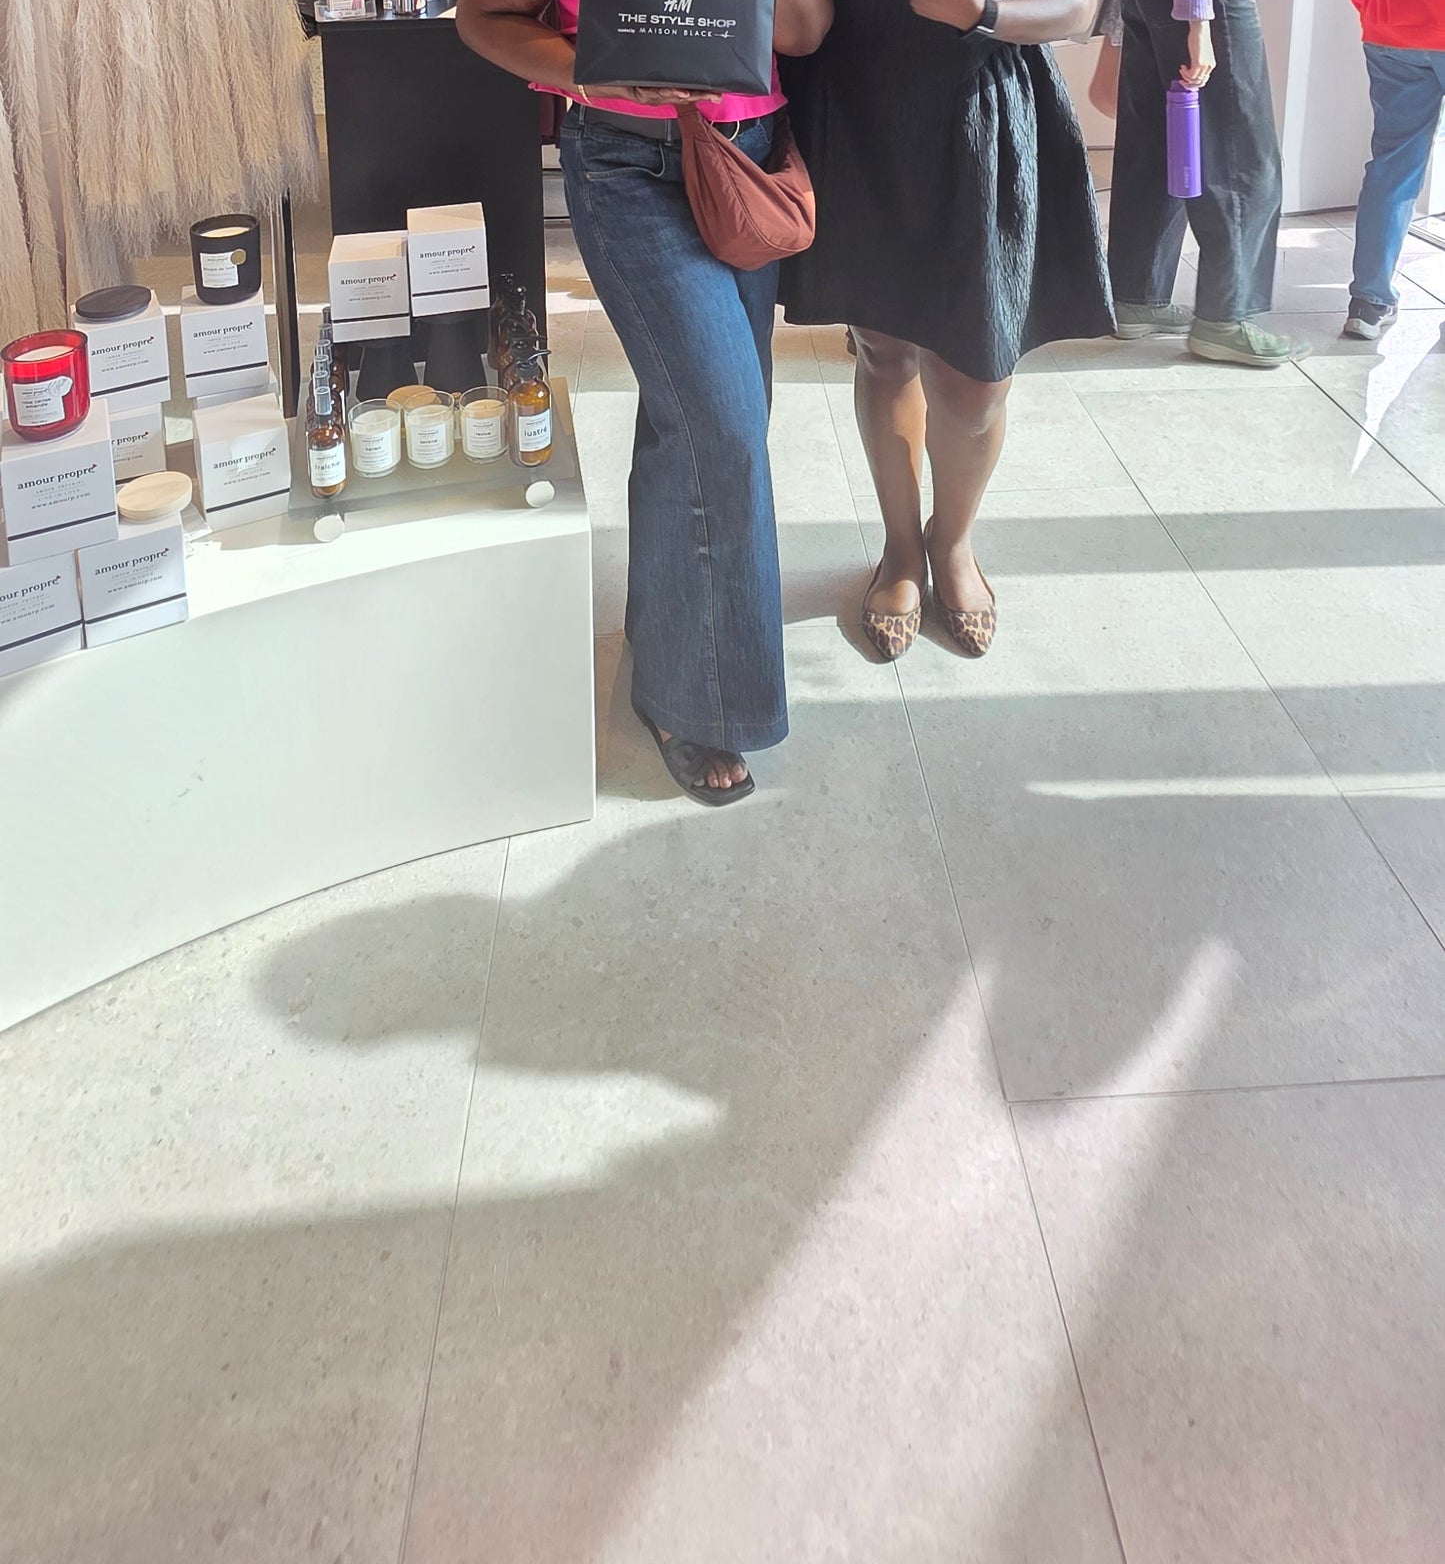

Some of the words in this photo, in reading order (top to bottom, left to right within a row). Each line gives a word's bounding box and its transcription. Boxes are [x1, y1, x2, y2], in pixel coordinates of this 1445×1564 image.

[618, 13, 647, 23] THE
[650, 15, 695, 26] STYLE
[697, 17, 737, 28] SHOP
[683, 29, 713, 37] BLACK
[420, 250, 446, 258] amour
[193, 328, 221, 338] amour
[91, 345, 121, 356] amour
[213, 457, 243, 469] amour
[17, 475, 55, 490] amour
[95, 561, 131, 575] amour
[0, 590, 19, 602] our
